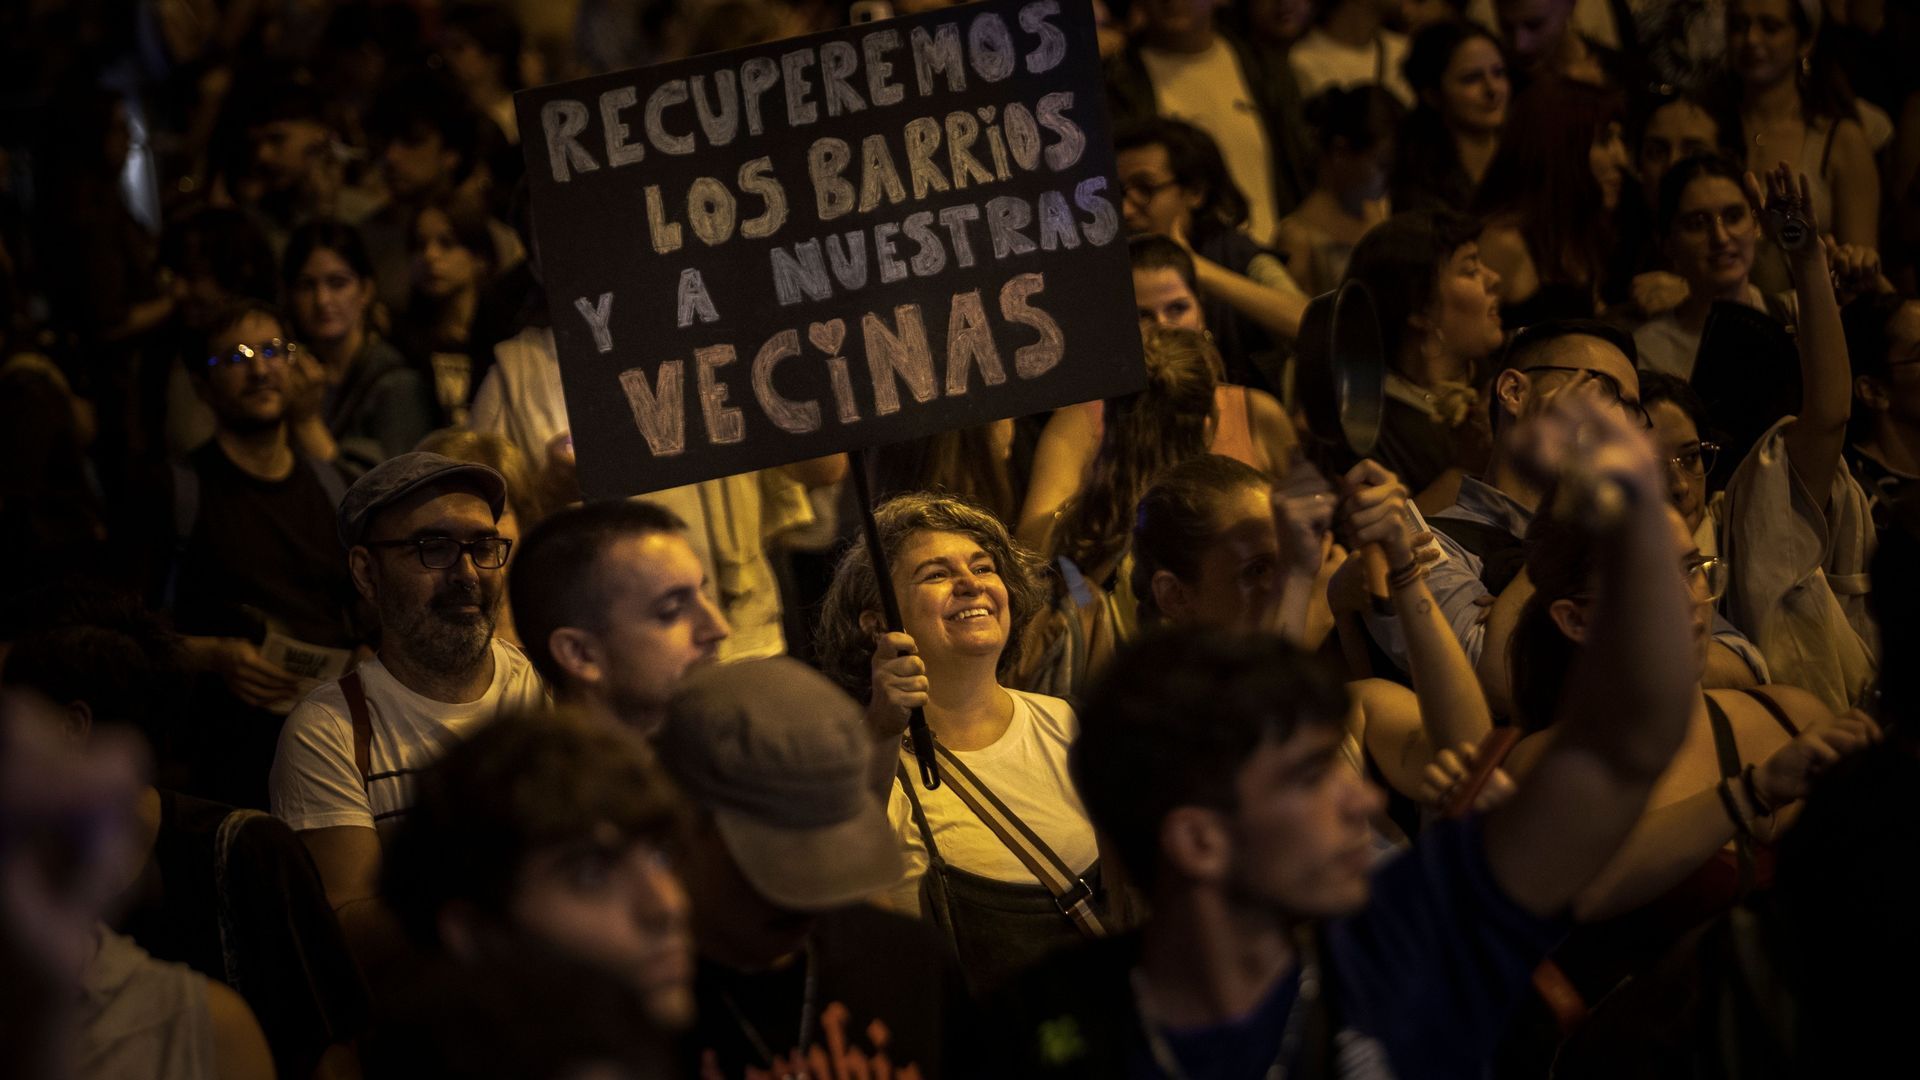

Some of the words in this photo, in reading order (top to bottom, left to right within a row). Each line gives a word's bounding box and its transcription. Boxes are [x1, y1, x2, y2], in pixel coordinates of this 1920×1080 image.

[541, 2, 1067, 182] RECUPEREMOS
[575, 293, 613, 353] Y
[677, 268, 720, 328] A
[771, 176, 1119, 305] NUESTRAS
[644, 156, 788, 254] LOS
